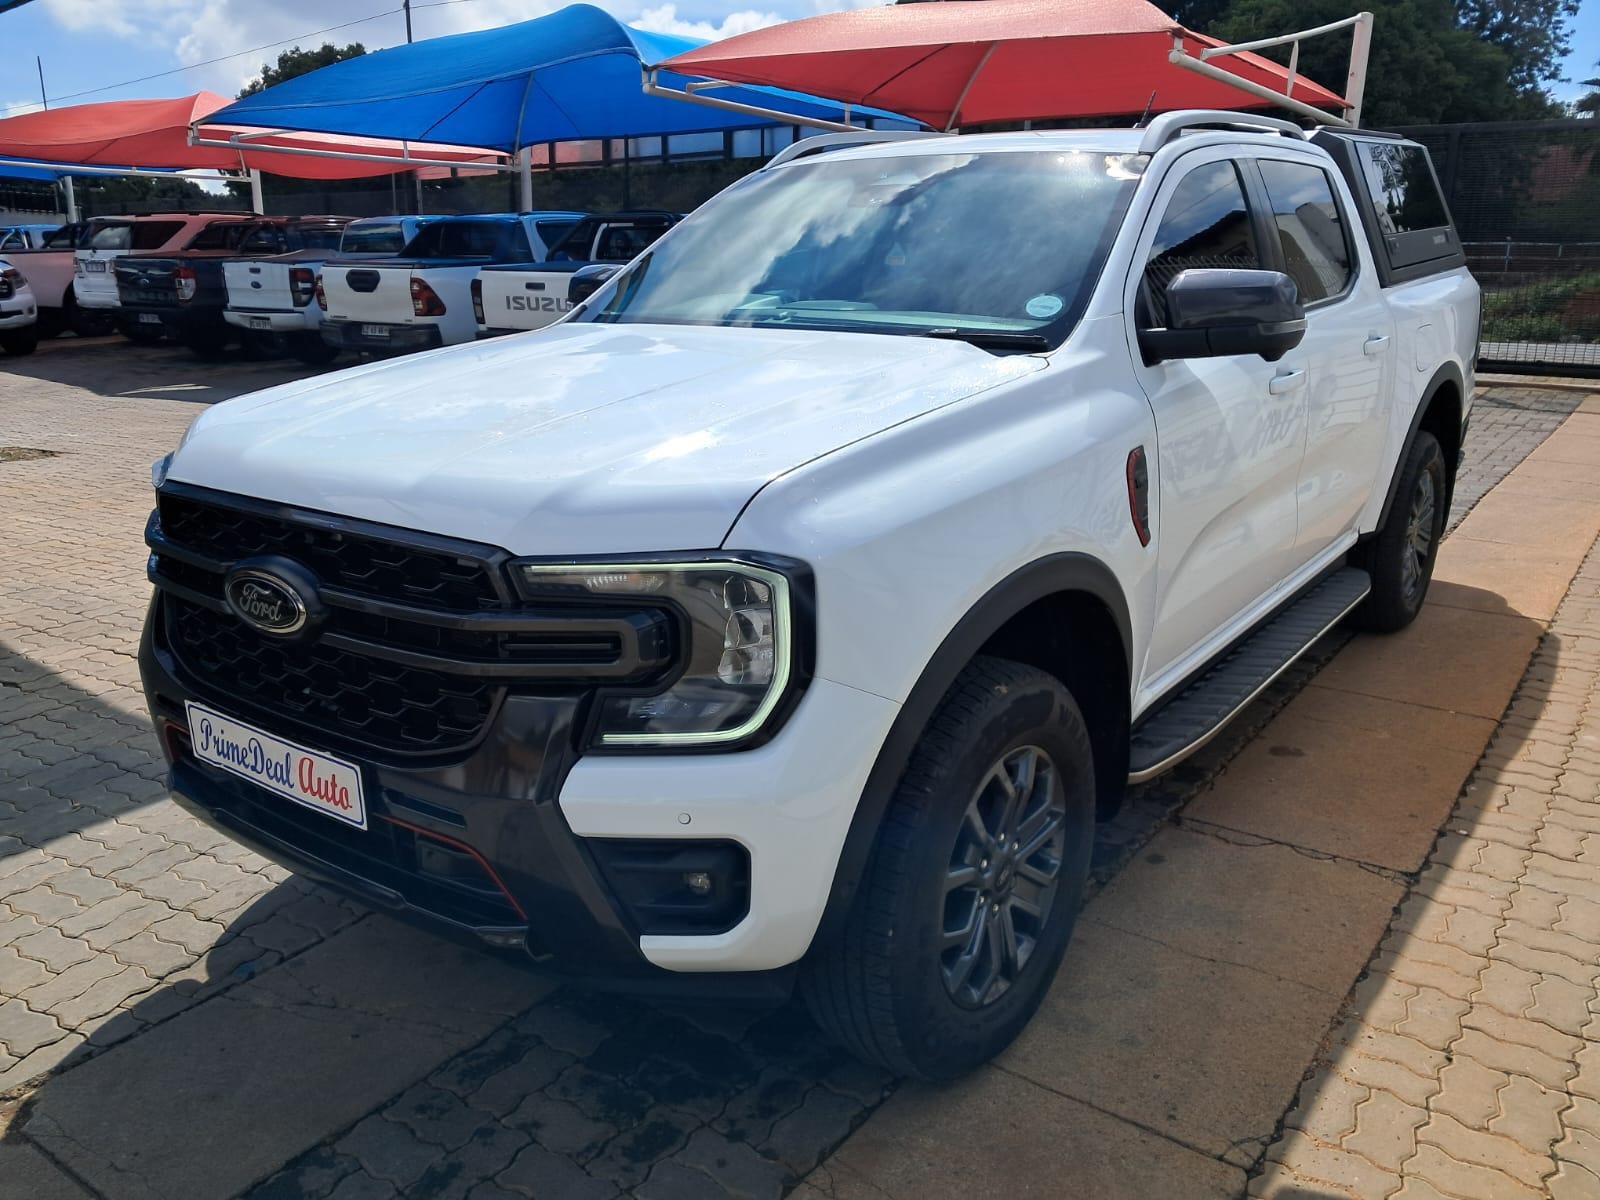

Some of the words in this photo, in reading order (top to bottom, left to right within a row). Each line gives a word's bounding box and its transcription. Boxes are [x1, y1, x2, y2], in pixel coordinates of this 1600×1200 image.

[240, 583, 282, 620] Ford
[200, 718, 294, 789] PrimeDeal
[299, 757, 352, 810] Auto
